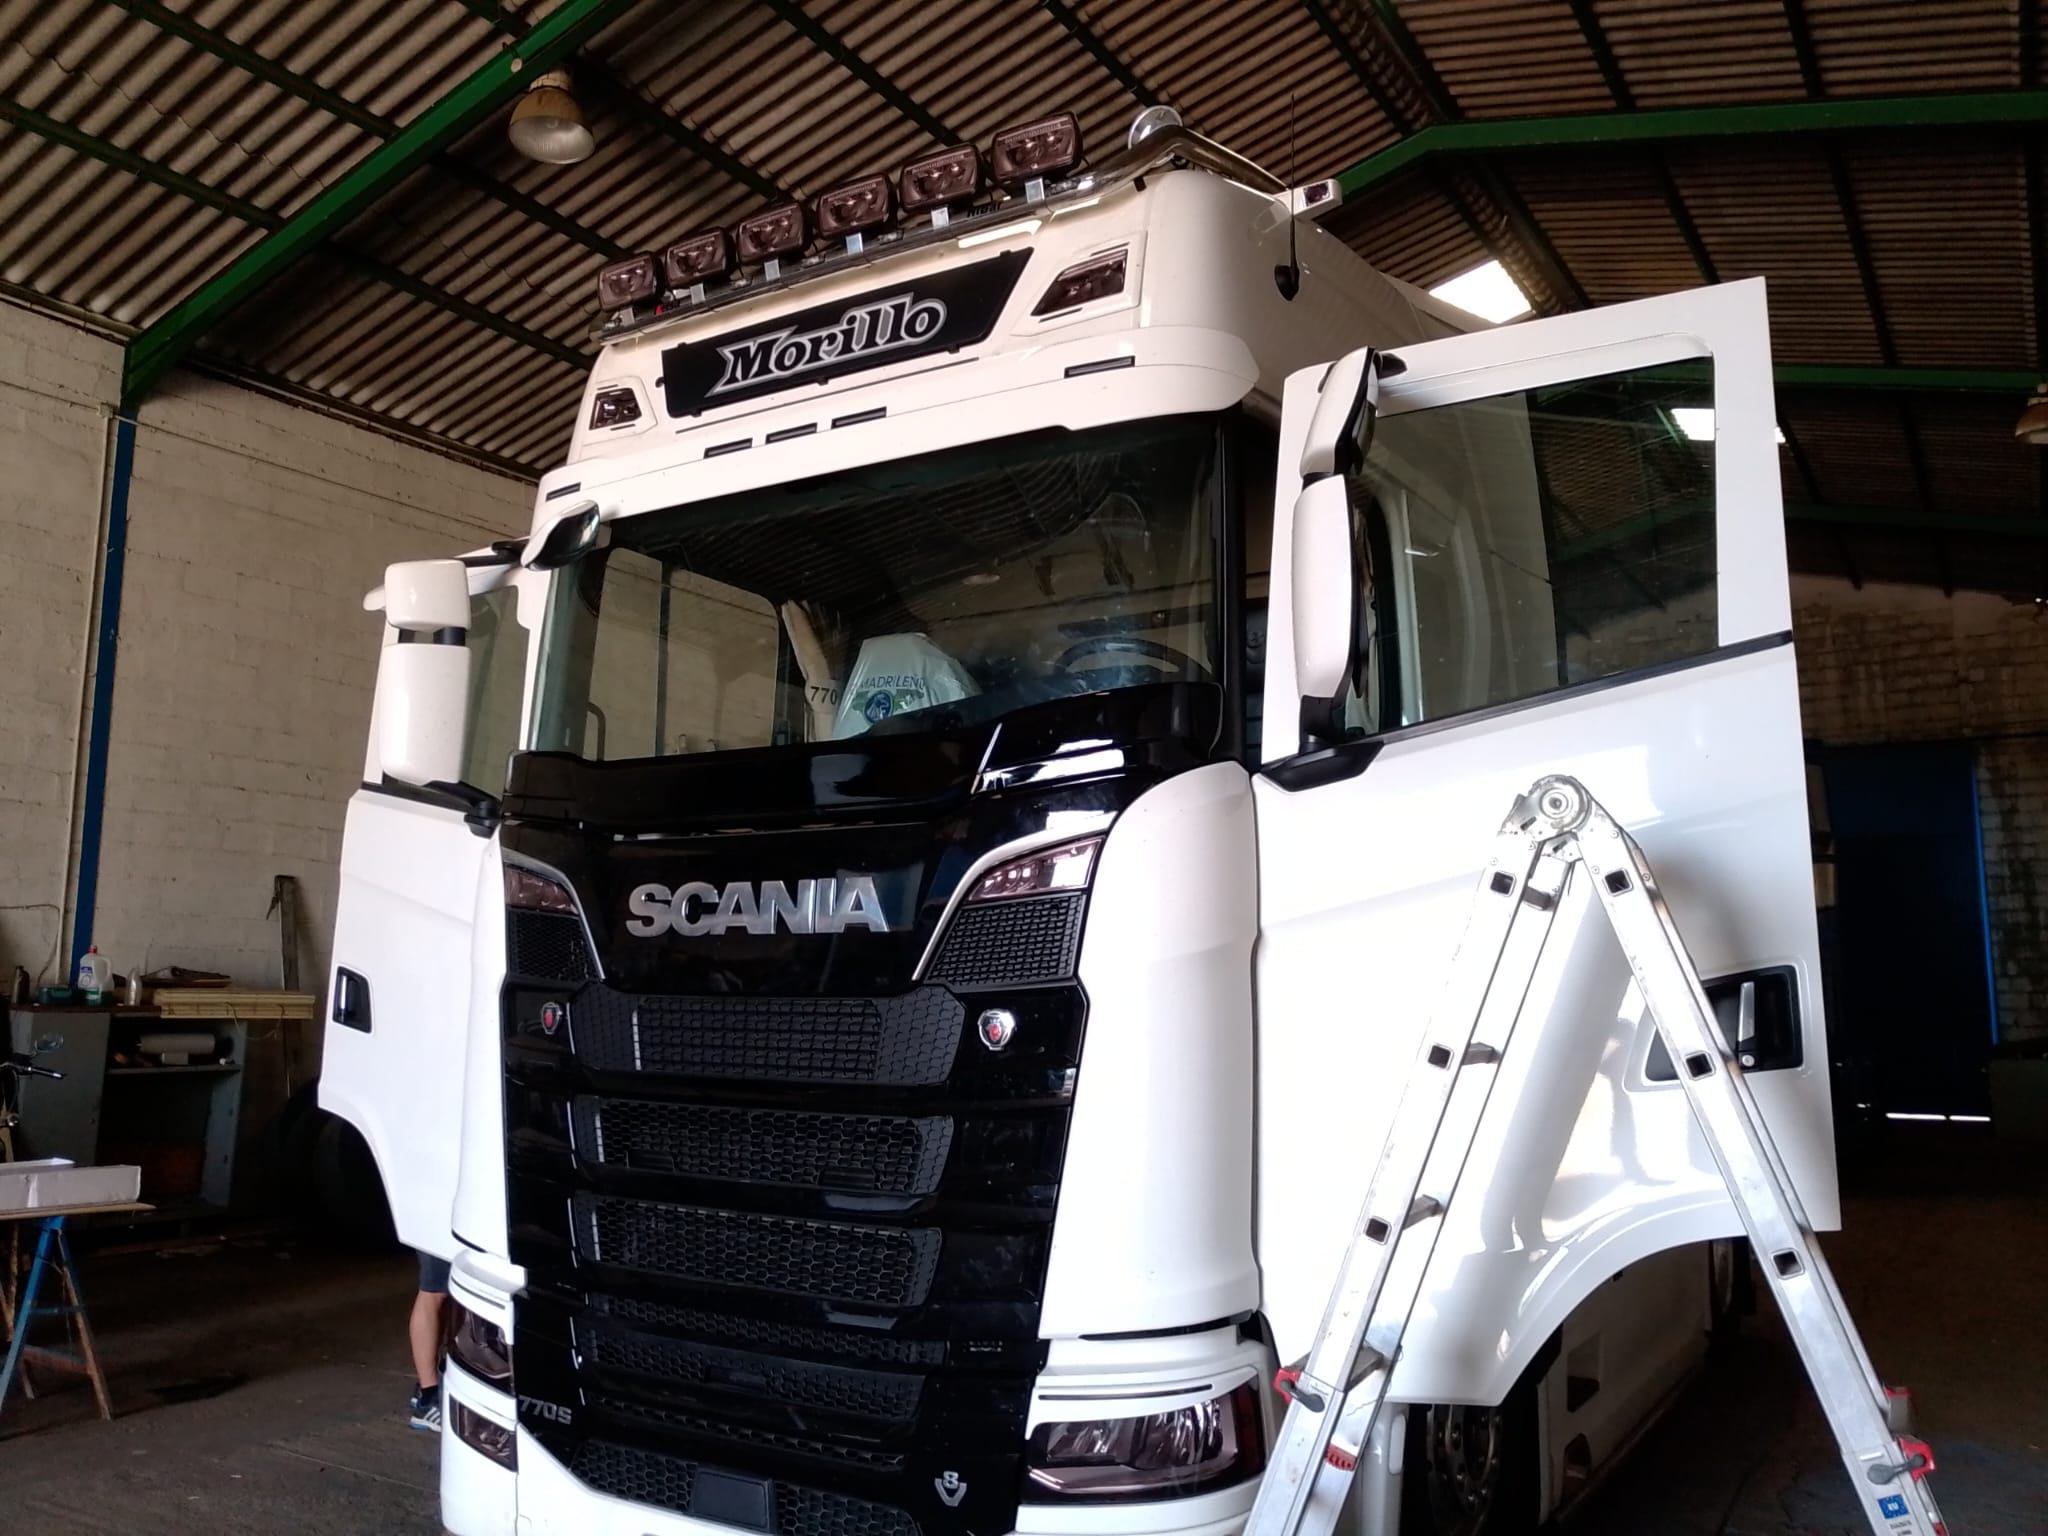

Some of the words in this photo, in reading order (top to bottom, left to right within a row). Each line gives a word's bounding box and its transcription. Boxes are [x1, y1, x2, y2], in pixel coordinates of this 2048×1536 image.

[714, 299, 946, 390] Morillo
[810, 686, 838, 705] 770
[626, 876, 889, 937] SCANIA
[518, 1394, 572, 1425] 770S
